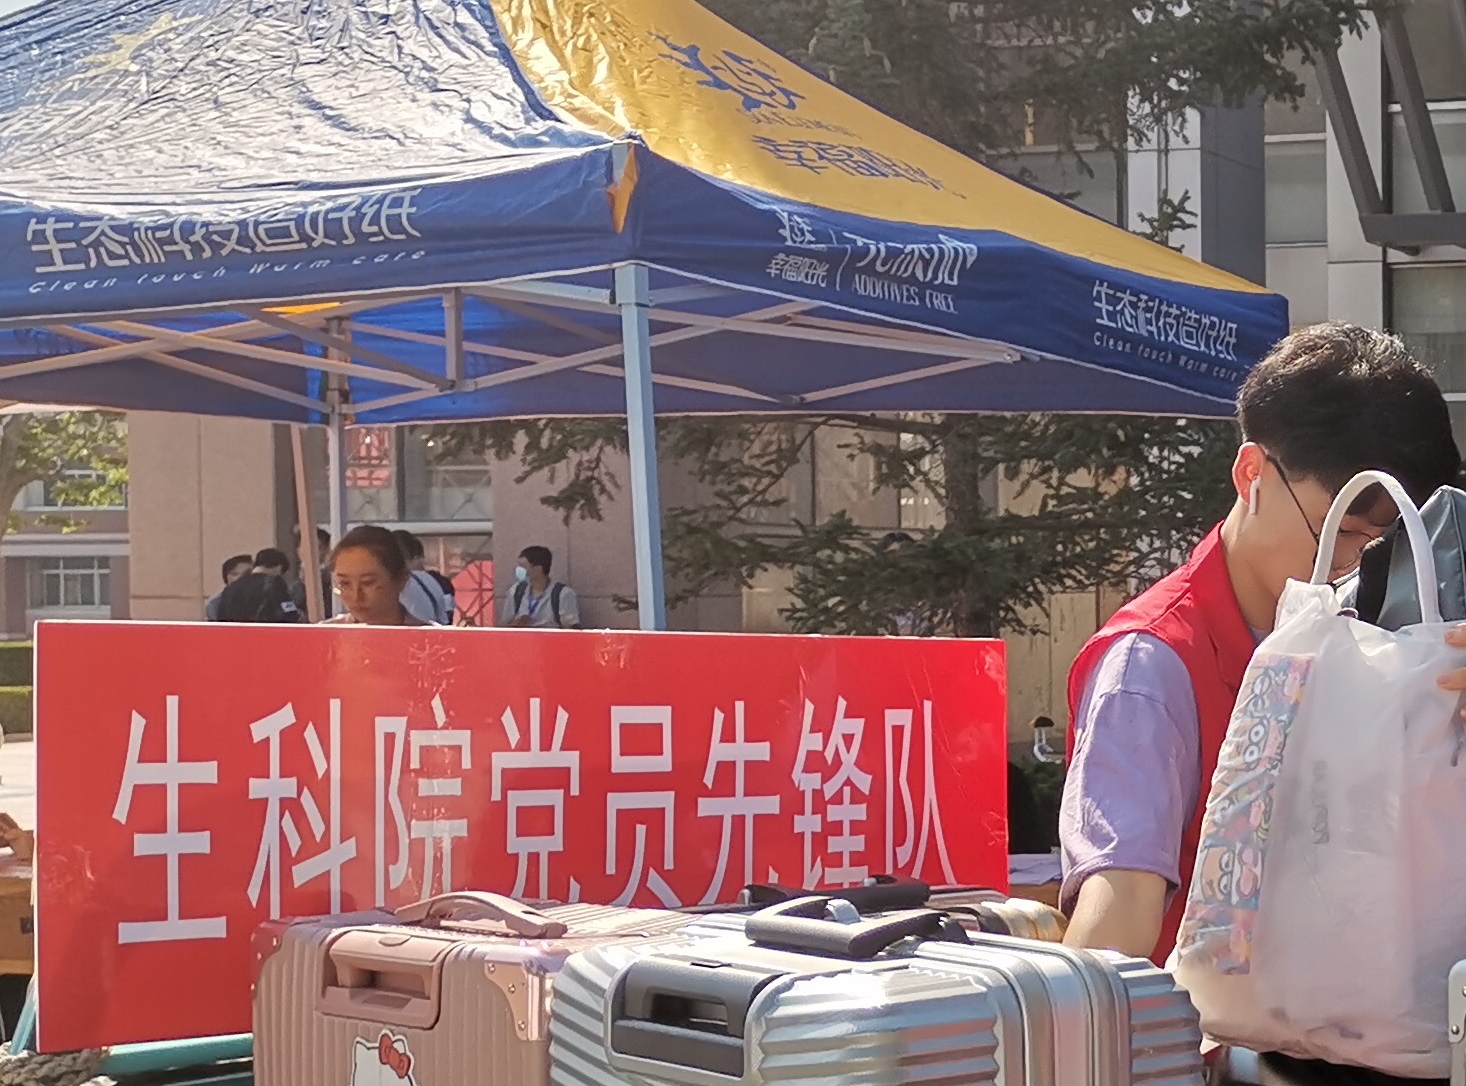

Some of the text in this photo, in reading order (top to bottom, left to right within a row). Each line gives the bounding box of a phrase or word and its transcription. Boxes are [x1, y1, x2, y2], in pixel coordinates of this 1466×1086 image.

[28, 277, 118, 294] Clean
[351, 249, 427, 265] care
[765, 252, 830, 289] 幸福阳光
[852, 273, 958, 315] ADDITIVES FREE
[1092, 279, 1238, 362] 生态科技造好纸
[1093, 331, 1131, 354] Clean
[111, 693, 959, 945] 生科院党员先锋队
